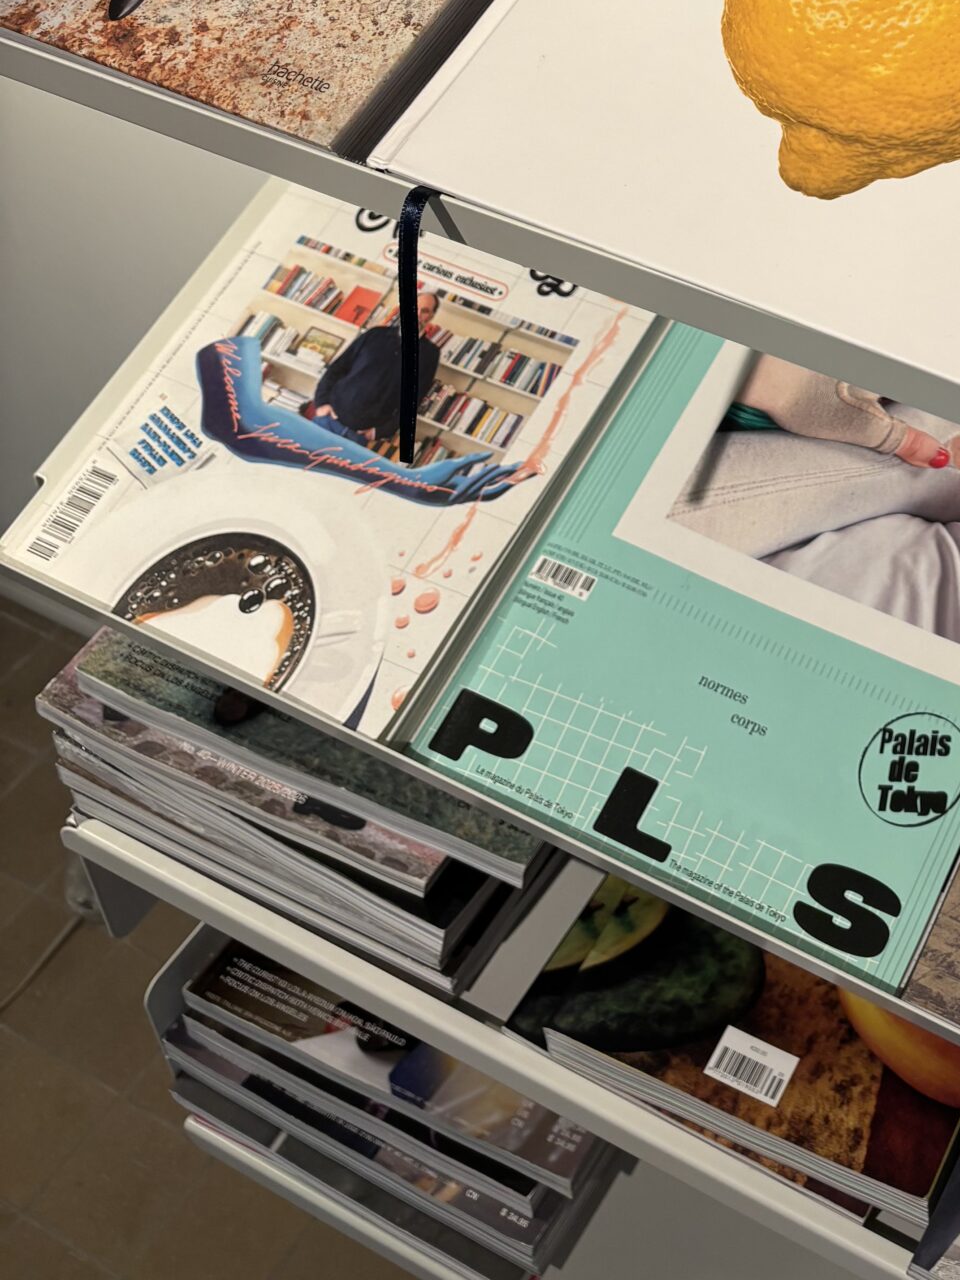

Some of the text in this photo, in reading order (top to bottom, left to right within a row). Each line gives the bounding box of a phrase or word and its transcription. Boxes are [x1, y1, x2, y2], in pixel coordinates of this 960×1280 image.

[267, 60, 331, 94] hachette
[422, 261, 498, 295] curious enthusiast
[214, 333, 242, 433] Welcome
[698, 675, 750, 706] normes
[730, 710, 769, 739] corps
[879, 727, 952, 759] Palais
[888, 755, 920, 783] de
[475, 764, 574, 820] Le magazine du Palais de Tokyo
[877, 784, 949, 815] Tokyo
[428, 688, 535, 761] P
[593, 766, 673, 864] L
[792, 863, 903, 958] S
[669, 858, 787, 923] The magazine of the Palais de Tokyo
